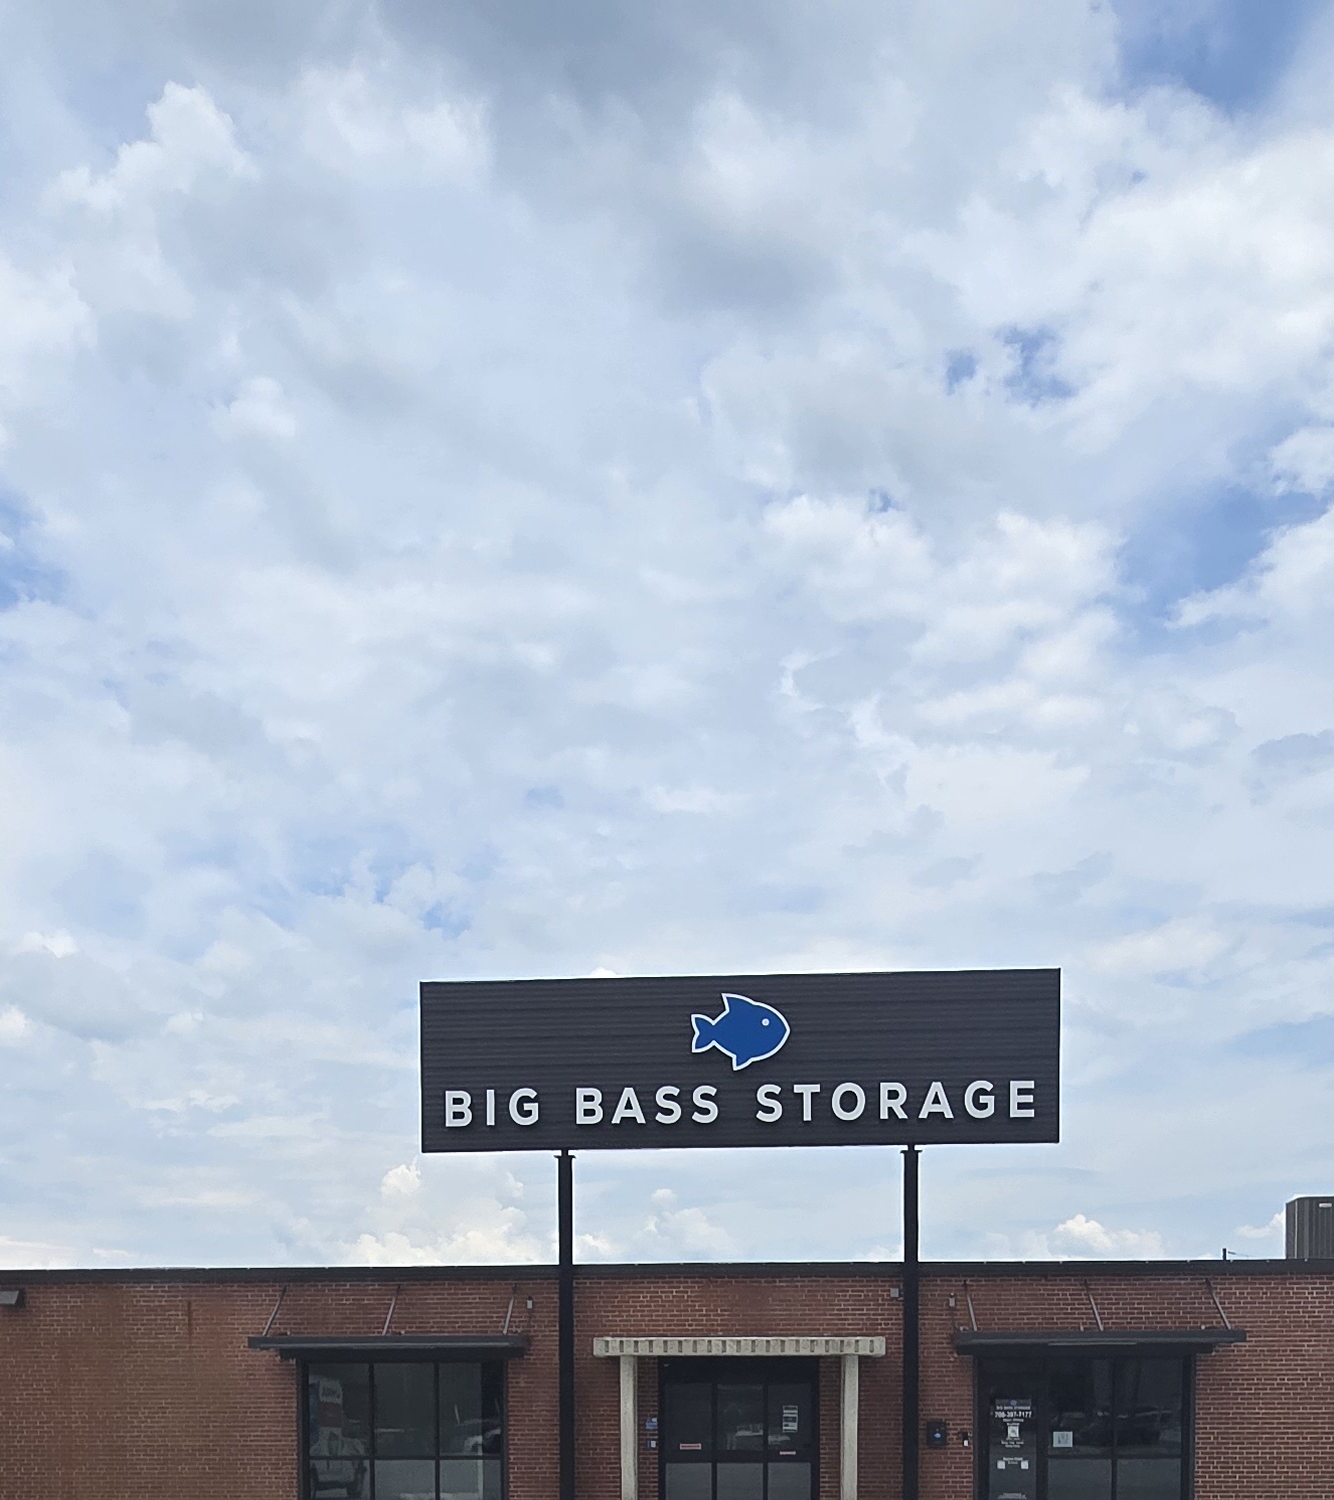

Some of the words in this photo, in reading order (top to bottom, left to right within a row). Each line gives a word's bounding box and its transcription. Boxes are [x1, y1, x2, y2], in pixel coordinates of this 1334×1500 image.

[444, 1087, 539, 1127] BIG
[575, 1085, 719, 1125] BASS
[755, 1080, 1035, 1123] STORAGE
